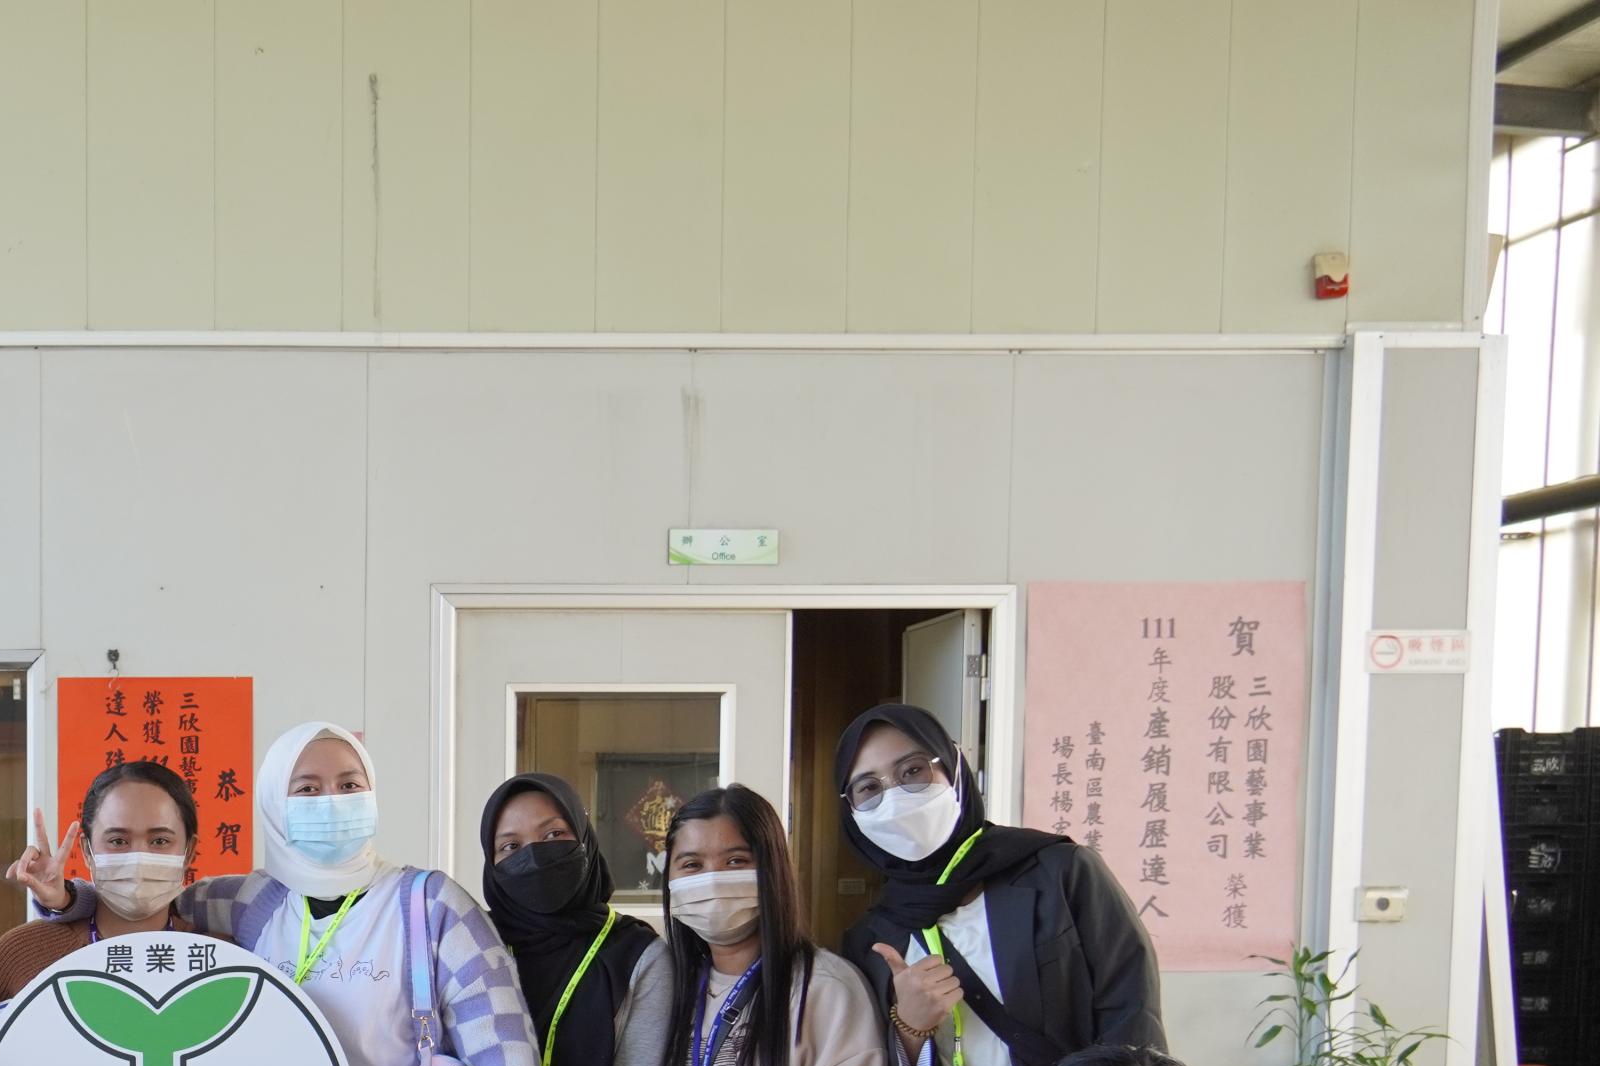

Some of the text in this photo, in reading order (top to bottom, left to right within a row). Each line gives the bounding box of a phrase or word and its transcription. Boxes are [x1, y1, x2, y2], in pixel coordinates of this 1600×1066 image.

[711, 551, 736, 560] Office
[1228, 615, 1260, 657] 賀
[1204, 674, 1239, 861] 股份有限公司
[1242, 675, 1274, 861] 三欣園藝事業
[213, 767, 246, 857] 恭賀
[1222, 872, 1250, 930] 榮獲
[104, 943, 217, 975] 農業部
